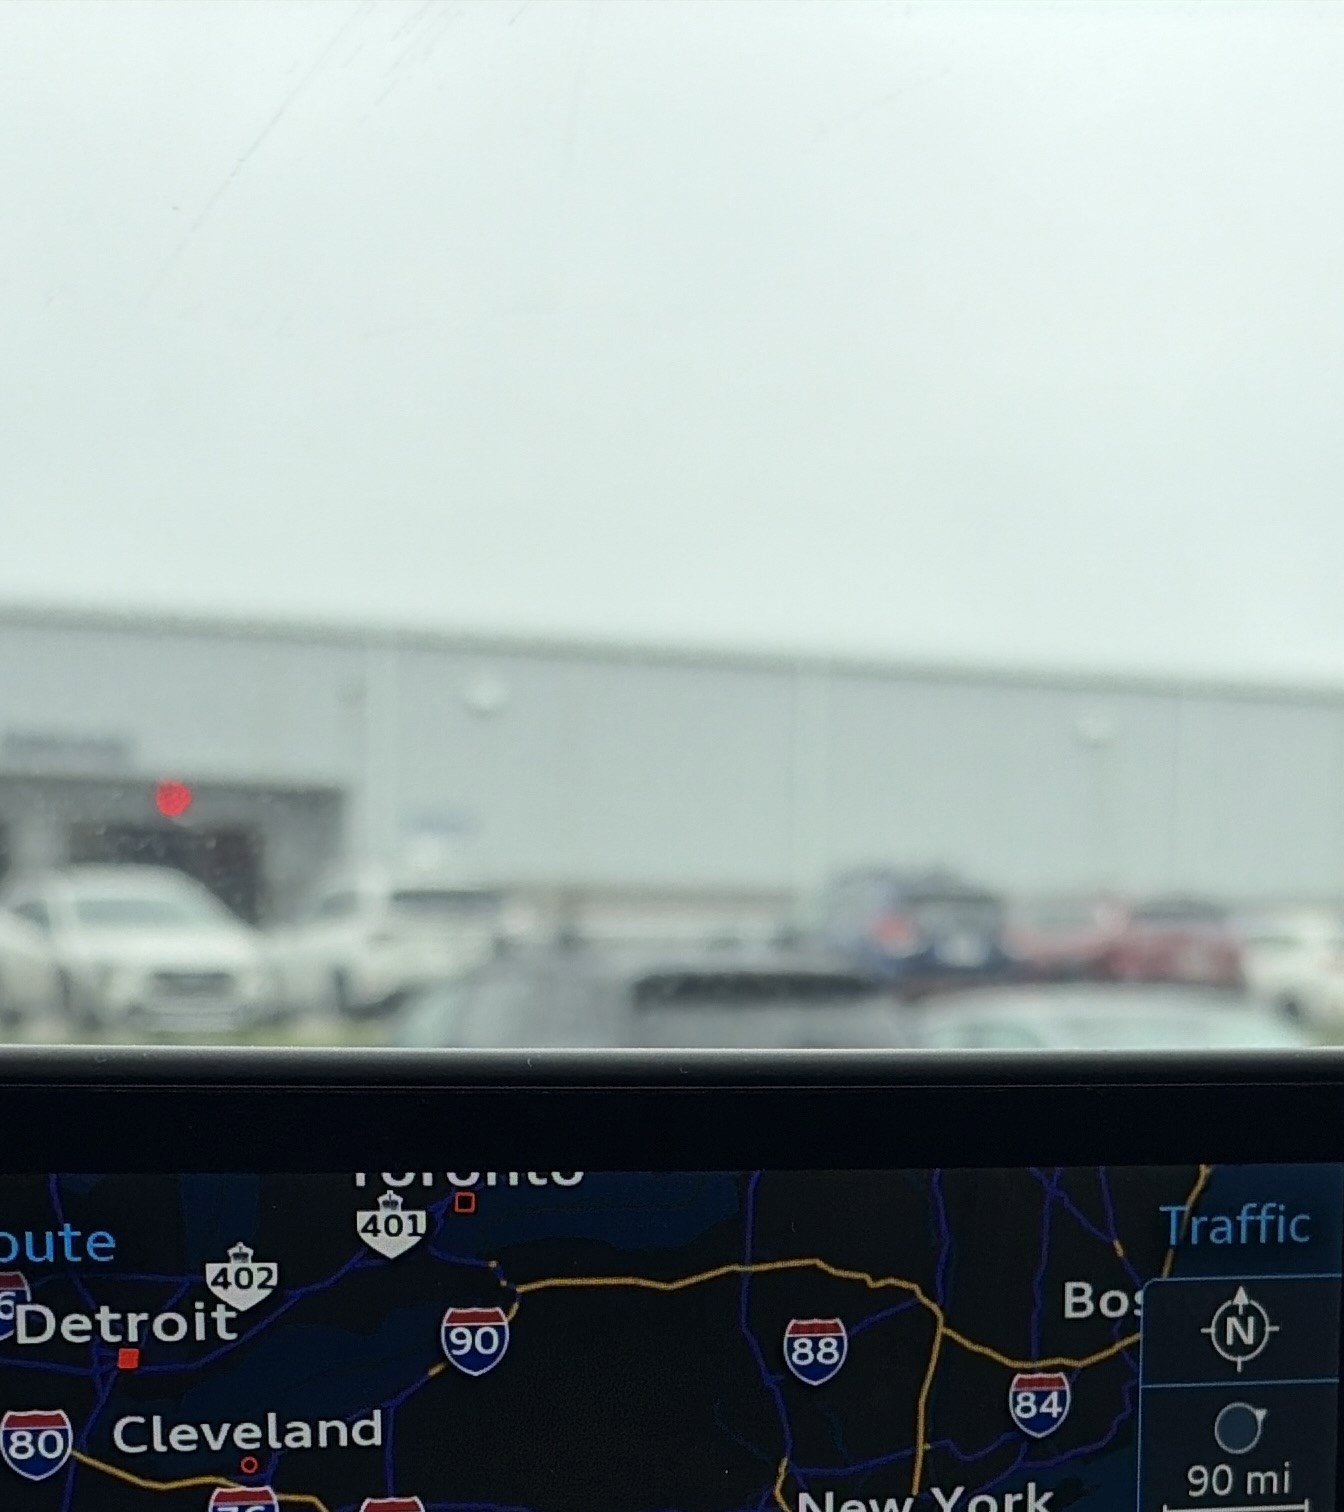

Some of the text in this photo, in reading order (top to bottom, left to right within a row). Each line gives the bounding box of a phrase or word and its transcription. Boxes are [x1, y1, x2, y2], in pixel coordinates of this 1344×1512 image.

[360, 1213, 425, 1239] 401
[1160, 1203, 1311, 1246] Traffic
[210, 1265, 278, 1291] 402
[16, 1302, 239, 1345] Detroit
[1226, 1314, 1256, 1347] N
[449, 1326, 499, 1356] 90
[791, 1336, 840, 1367] 88
[1014, 1390, 1063, 1420] 84
[8, 1429, 64, 1460] 80
[113, 1409, 383, 1454] Cleveland
[1187, 1461, 1291, 1497] 90 mi
